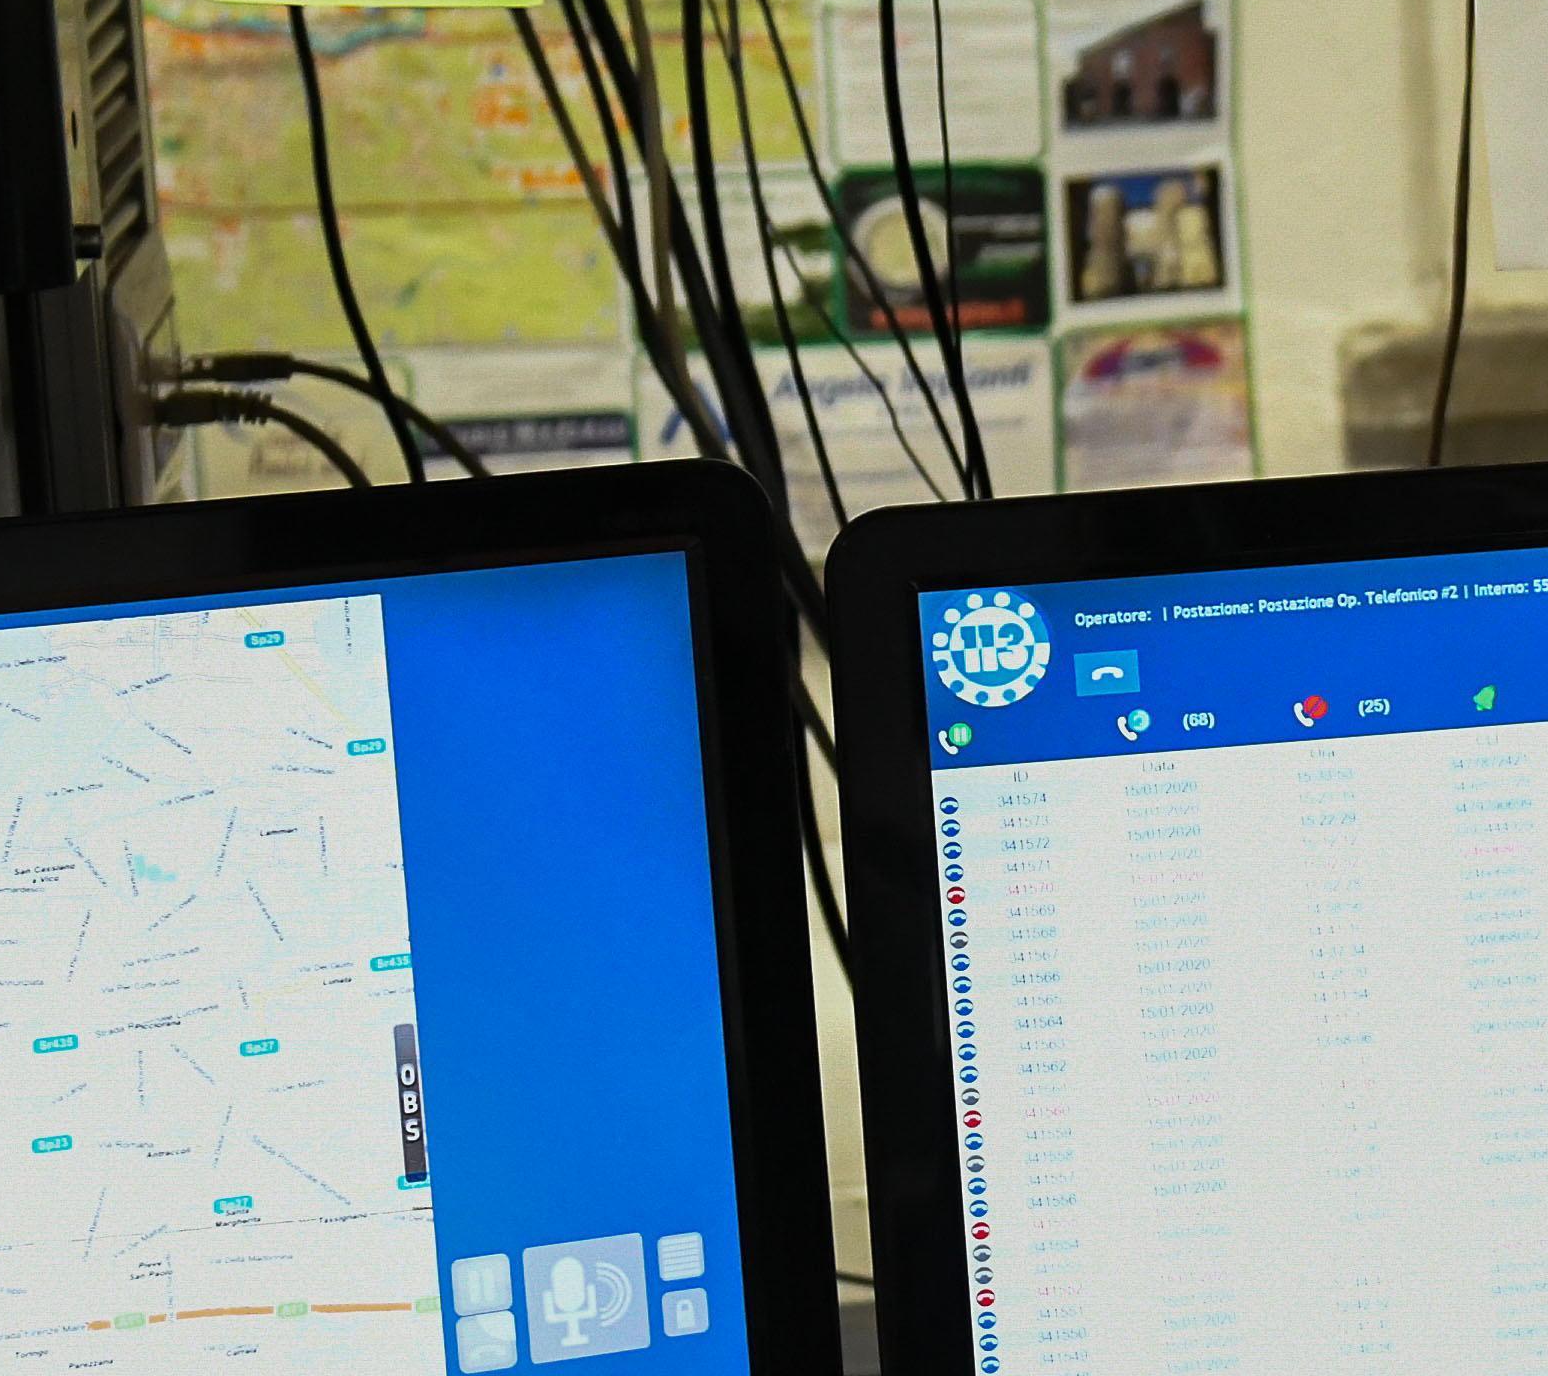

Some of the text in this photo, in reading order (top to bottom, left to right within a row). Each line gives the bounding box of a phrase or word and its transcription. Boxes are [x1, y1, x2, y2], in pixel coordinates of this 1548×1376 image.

[1075, 611, 1151, 628] Operatore:
[1173, 603, 1254, 619] Postazione:
[1258, 596, 1334, 612] Postazione
[1337, 593, 1361, 609] Op.
[1365, 588, 1438, 604] Telefonico
[1474, 583, 1529, 596] Interno:
[961, 623, 1029, 673] 113
[1182, 713, 1215, 731] (68)
[1358, 698, 1390, 716] (25)
